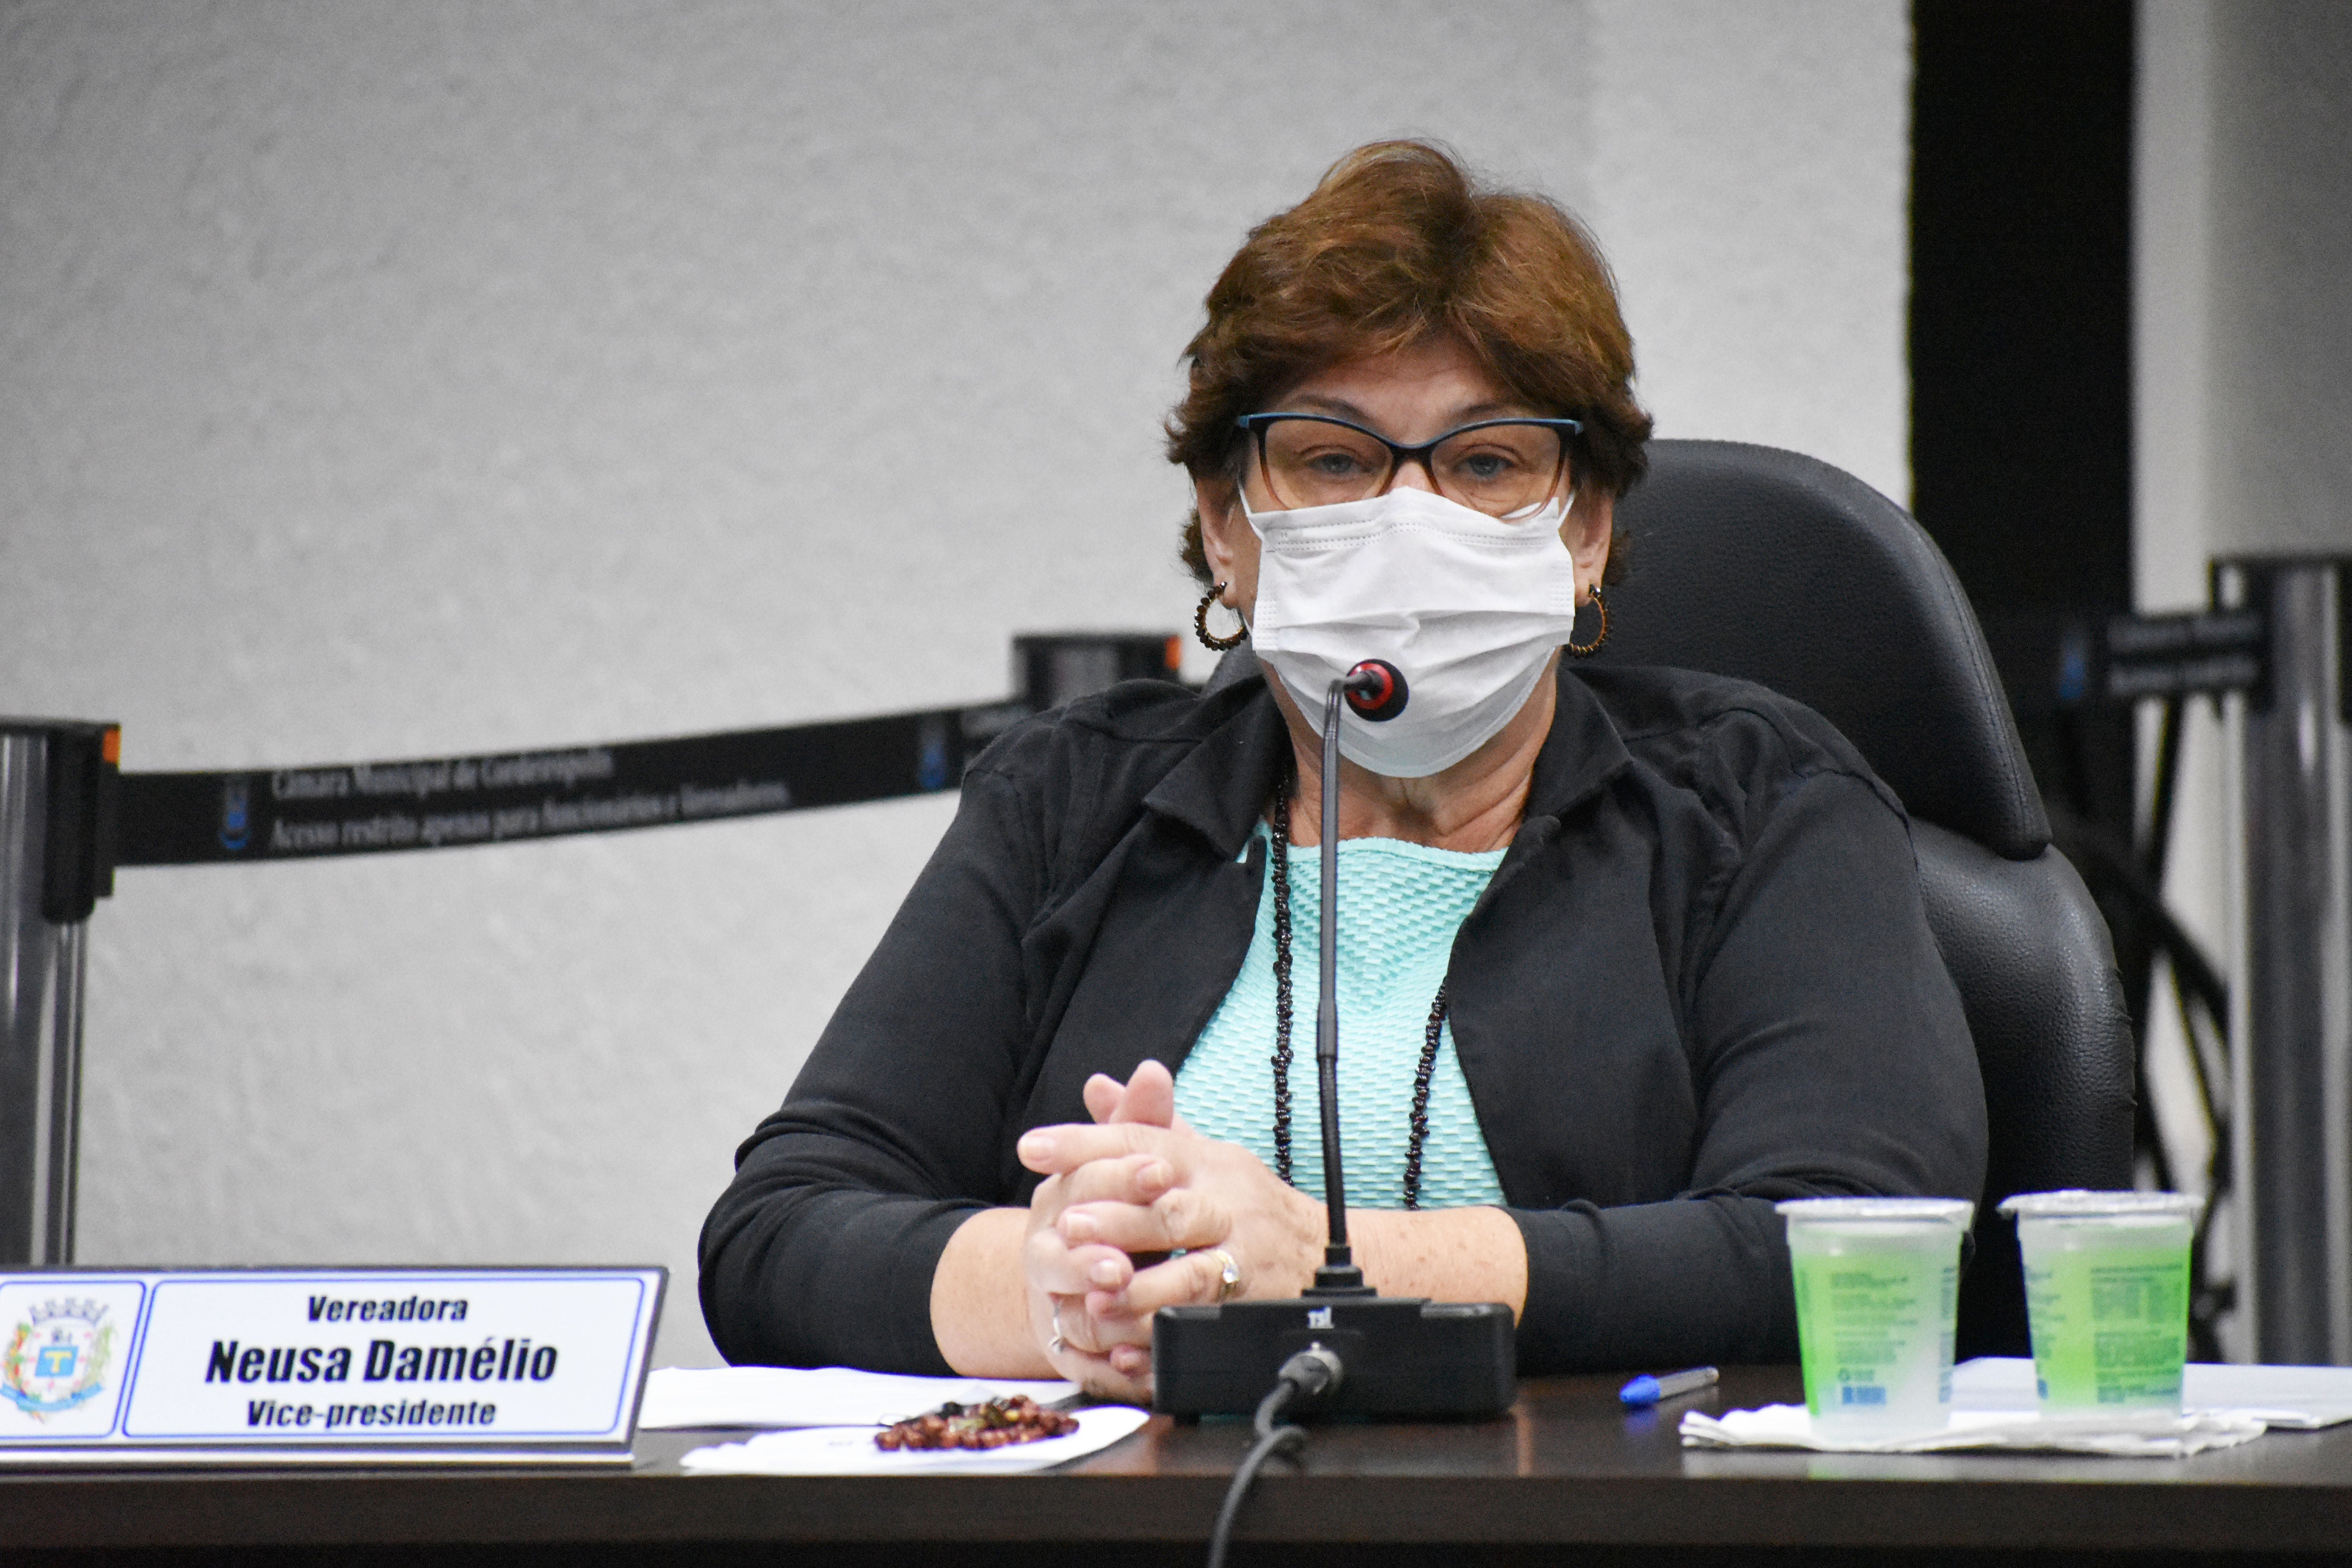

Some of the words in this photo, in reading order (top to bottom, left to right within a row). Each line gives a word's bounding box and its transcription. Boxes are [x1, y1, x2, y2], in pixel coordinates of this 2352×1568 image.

[309, 1296, 468, 1321] Vereadora
[206, 1341, 351, 1383] Neusa
[364, 1339, 557, 1381] Damélio
[248, 1400, 495, 1428] Vice-presidente
